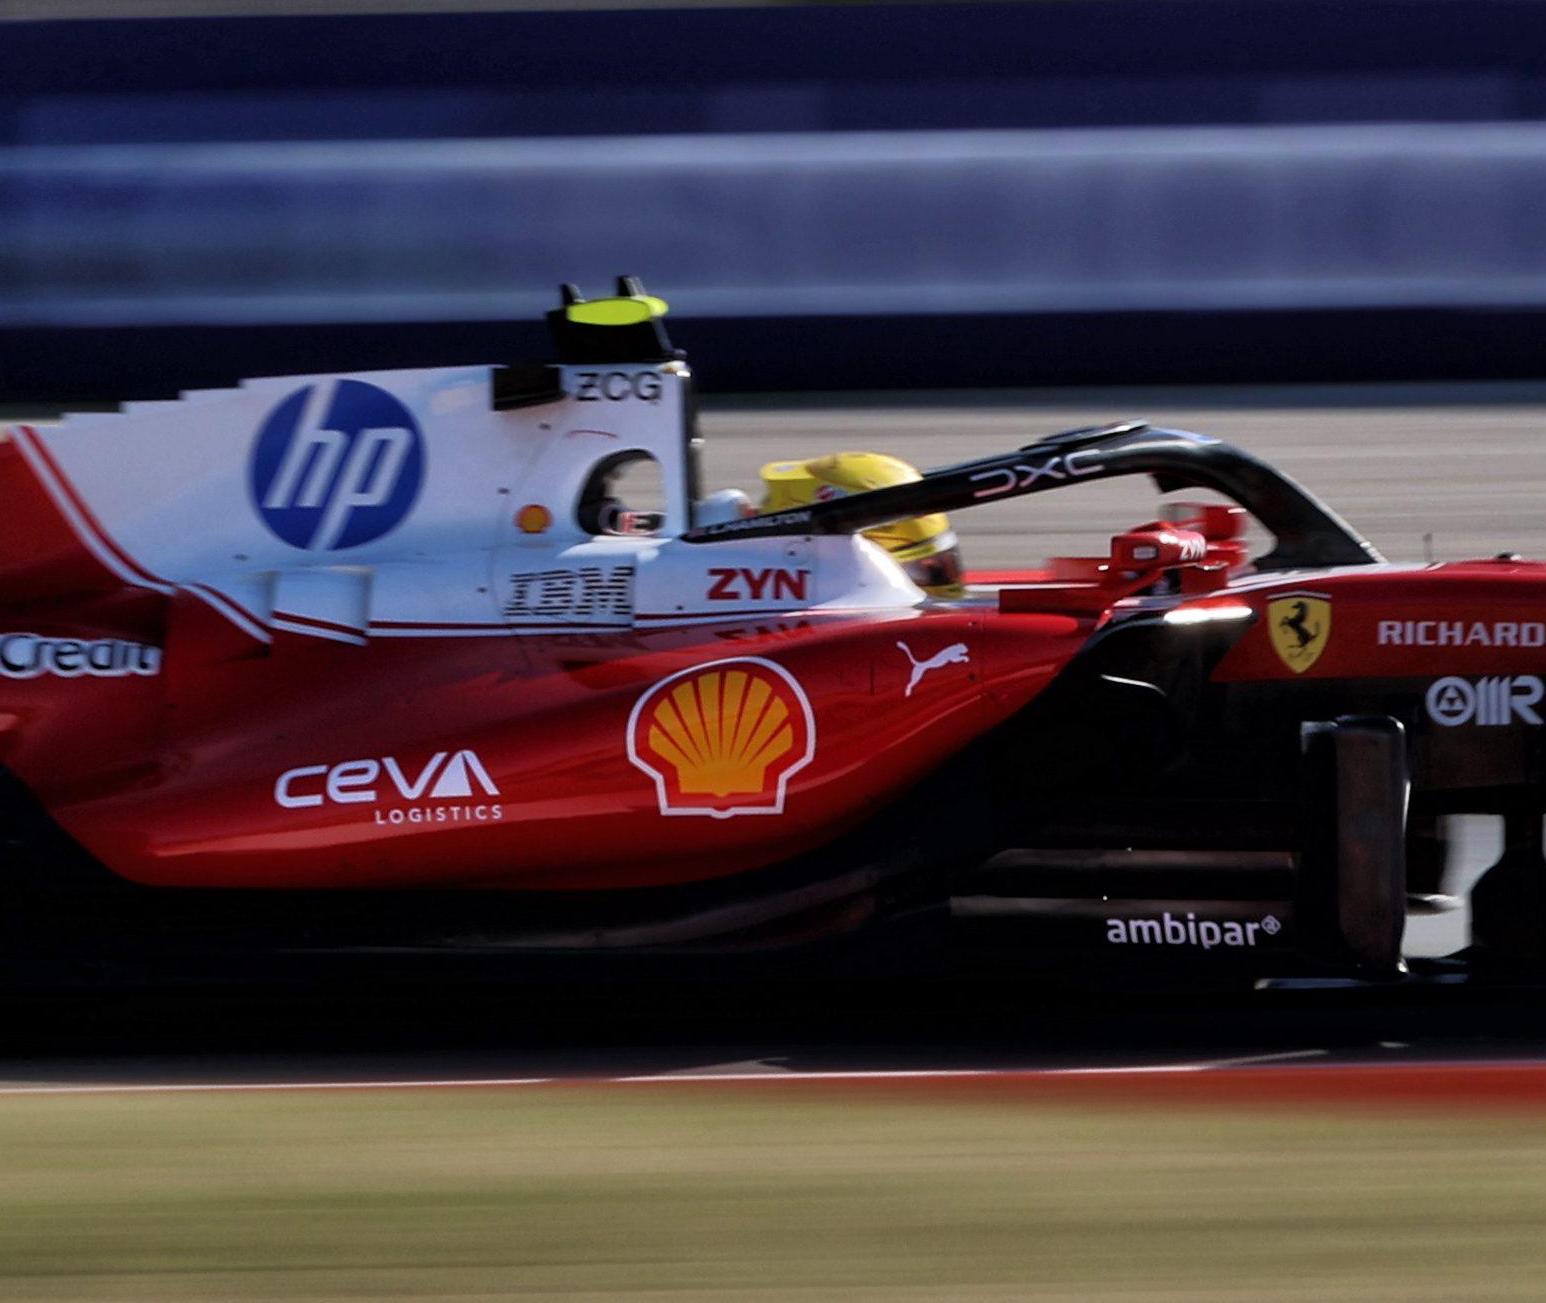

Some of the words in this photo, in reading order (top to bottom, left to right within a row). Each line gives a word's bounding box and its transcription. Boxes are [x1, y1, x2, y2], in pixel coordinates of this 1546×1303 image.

[262, 379, 413, 551] hp
[502, 566, 636, 616] IBM
[706, 567, 810, 601] ZYN
[1377, 620, 1546, 648] RICHARD
[374, 804, 503, 826] LOGISTICS
[1106, 912, 1261, 950] ambipar
